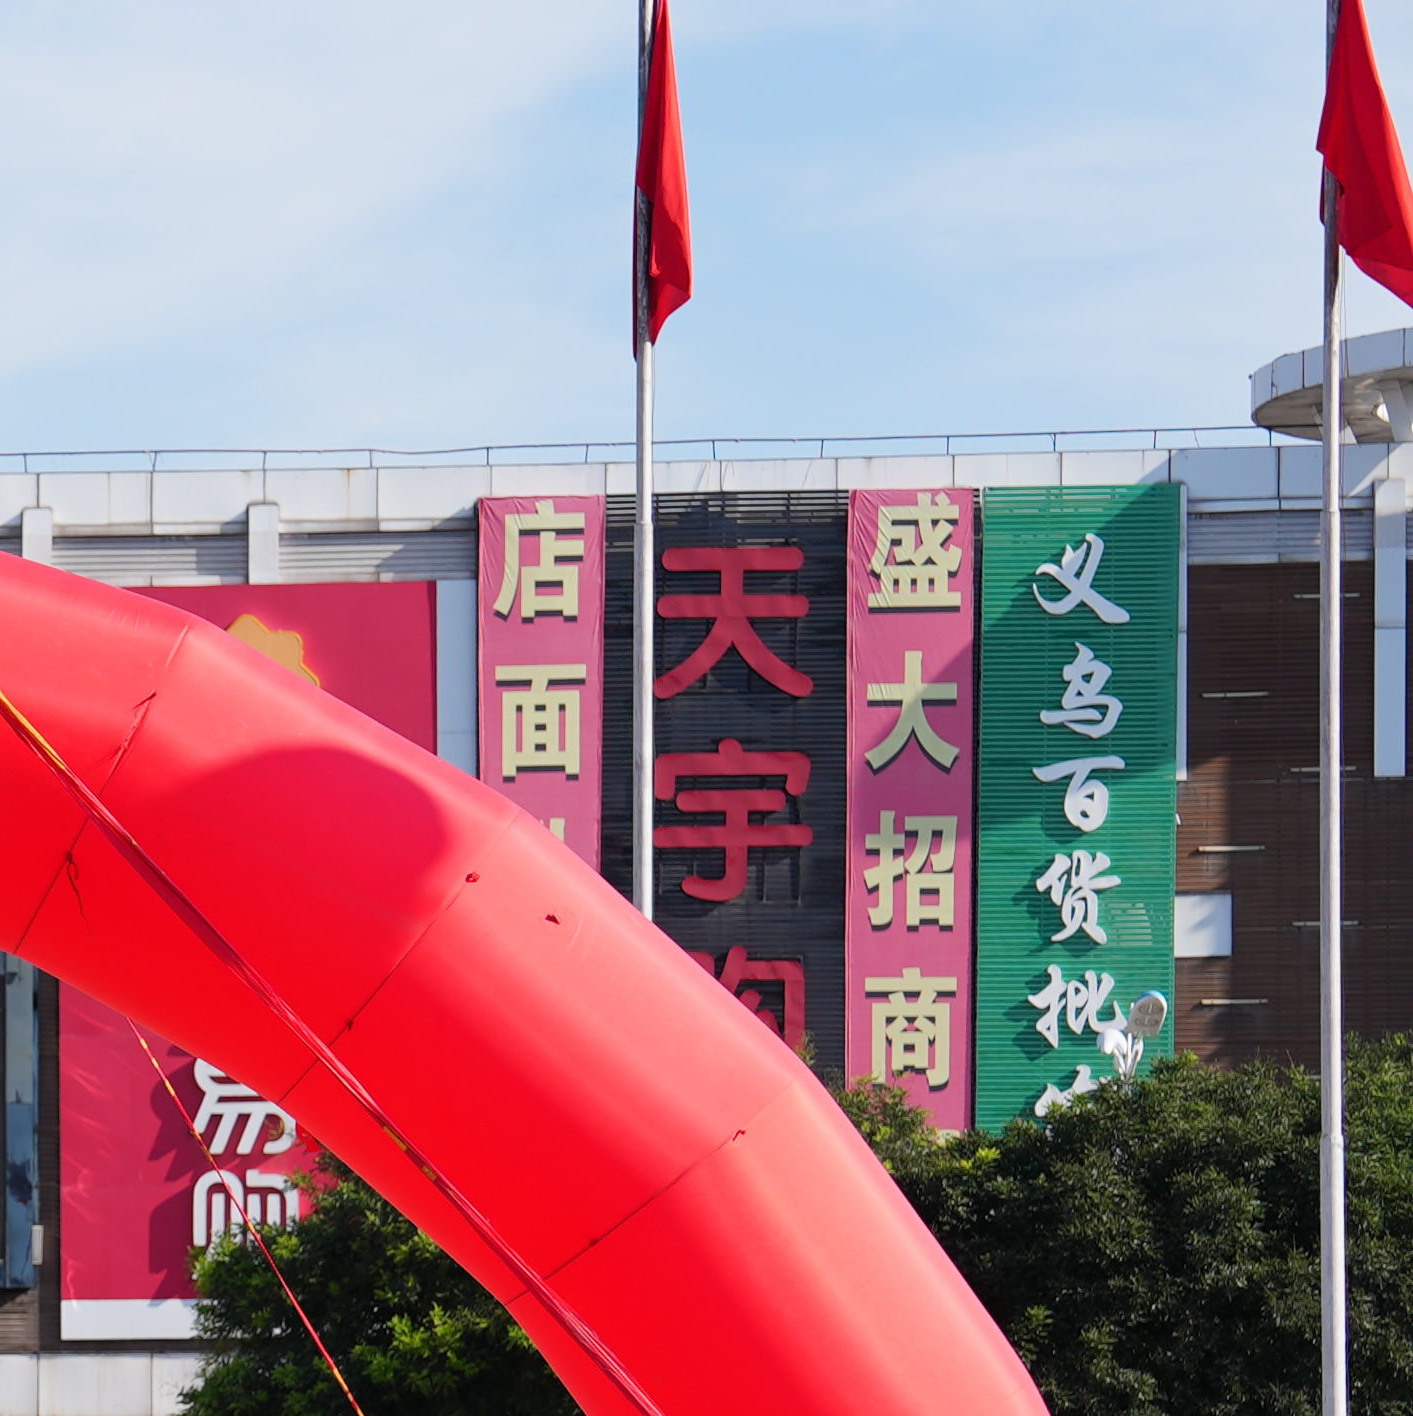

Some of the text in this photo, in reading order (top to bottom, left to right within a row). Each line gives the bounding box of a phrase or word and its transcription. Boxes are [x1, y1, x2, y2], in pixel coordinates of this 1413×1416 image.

[493, 501, 586, 848] 店面
[864, 492, 962, 1088] 盛大招商
